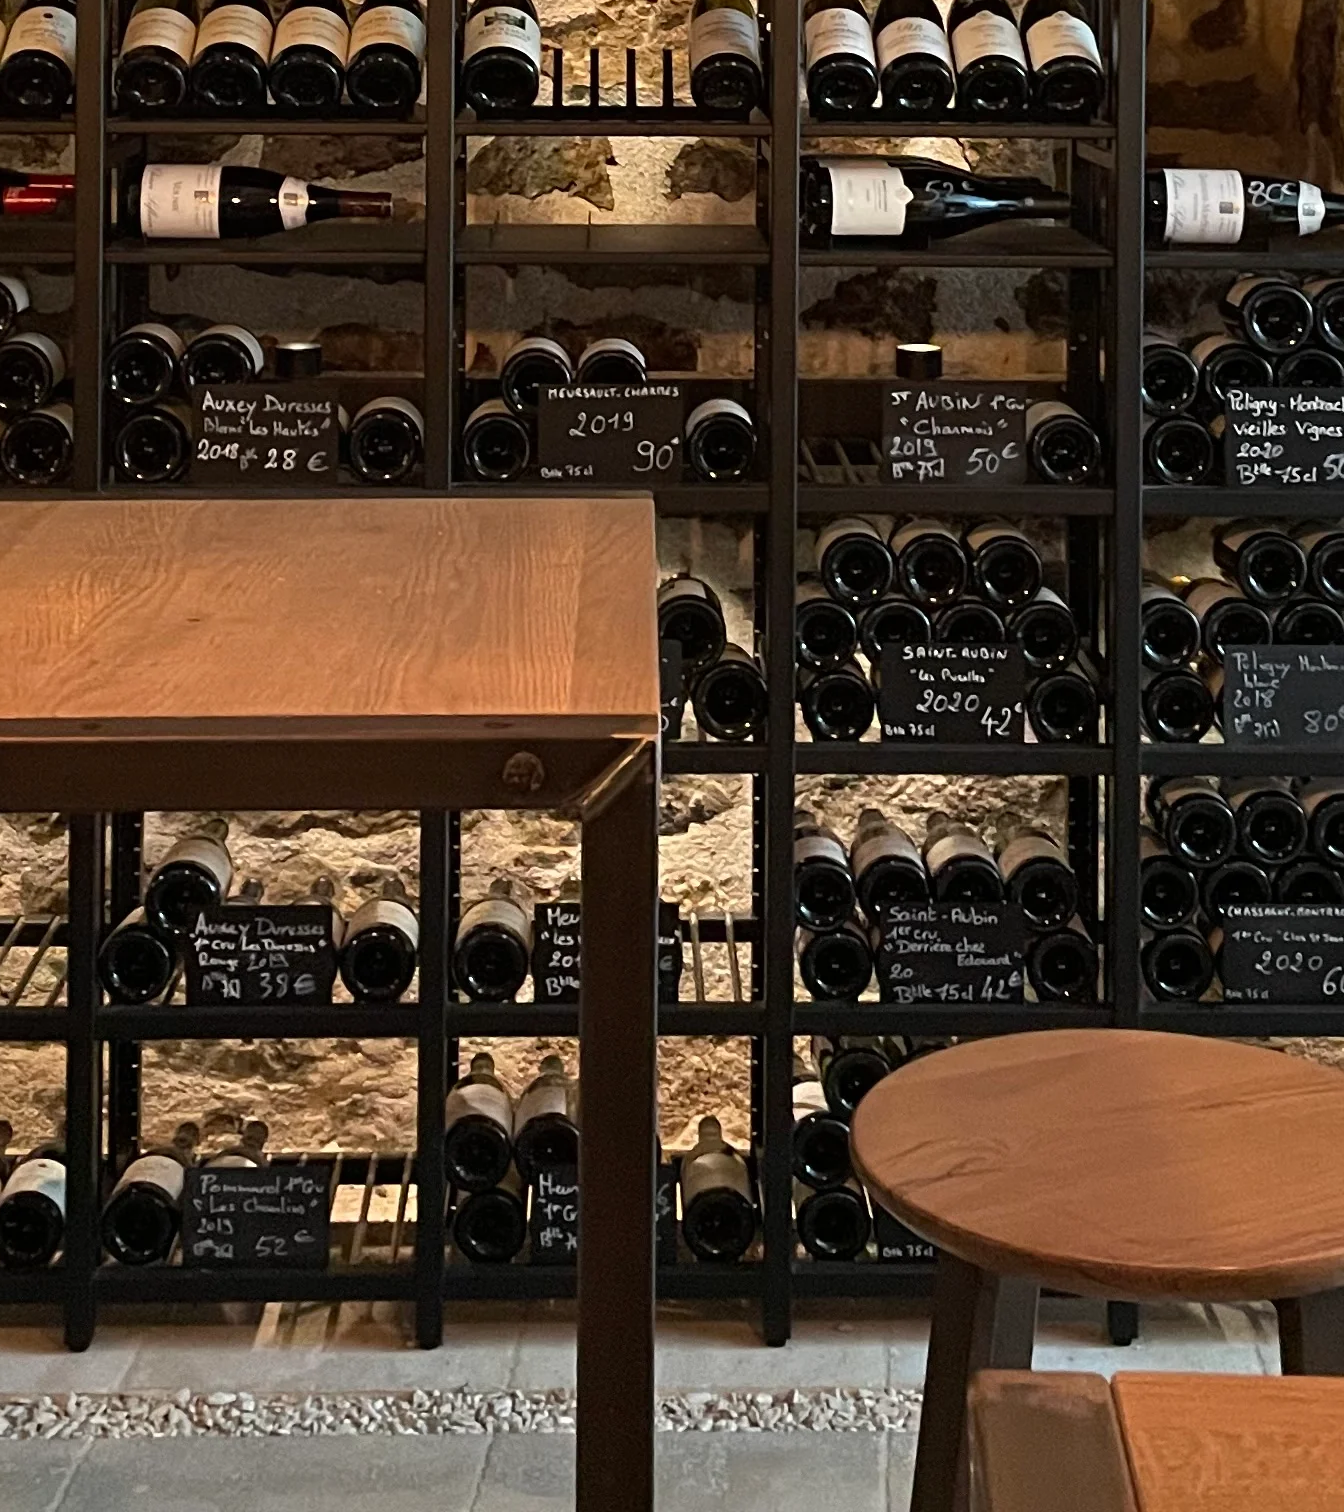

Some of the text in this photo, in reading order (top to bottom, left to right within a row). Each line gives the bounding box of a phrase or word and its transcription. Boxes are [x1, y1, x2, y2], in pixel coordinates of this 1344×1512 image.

[201, 390, 258, 422] Auxey
[568, 410, 634, 438] 2019
[197, 438, 240, 461] 2018
[889, 436, 939, 458] 2019
[1236, 441, 1285, 459] 2020
[917, 687, 981, 713] 2020
[1232, 688, 1278, 708] 2018
[1254, 950, 1324, 976] 2020
